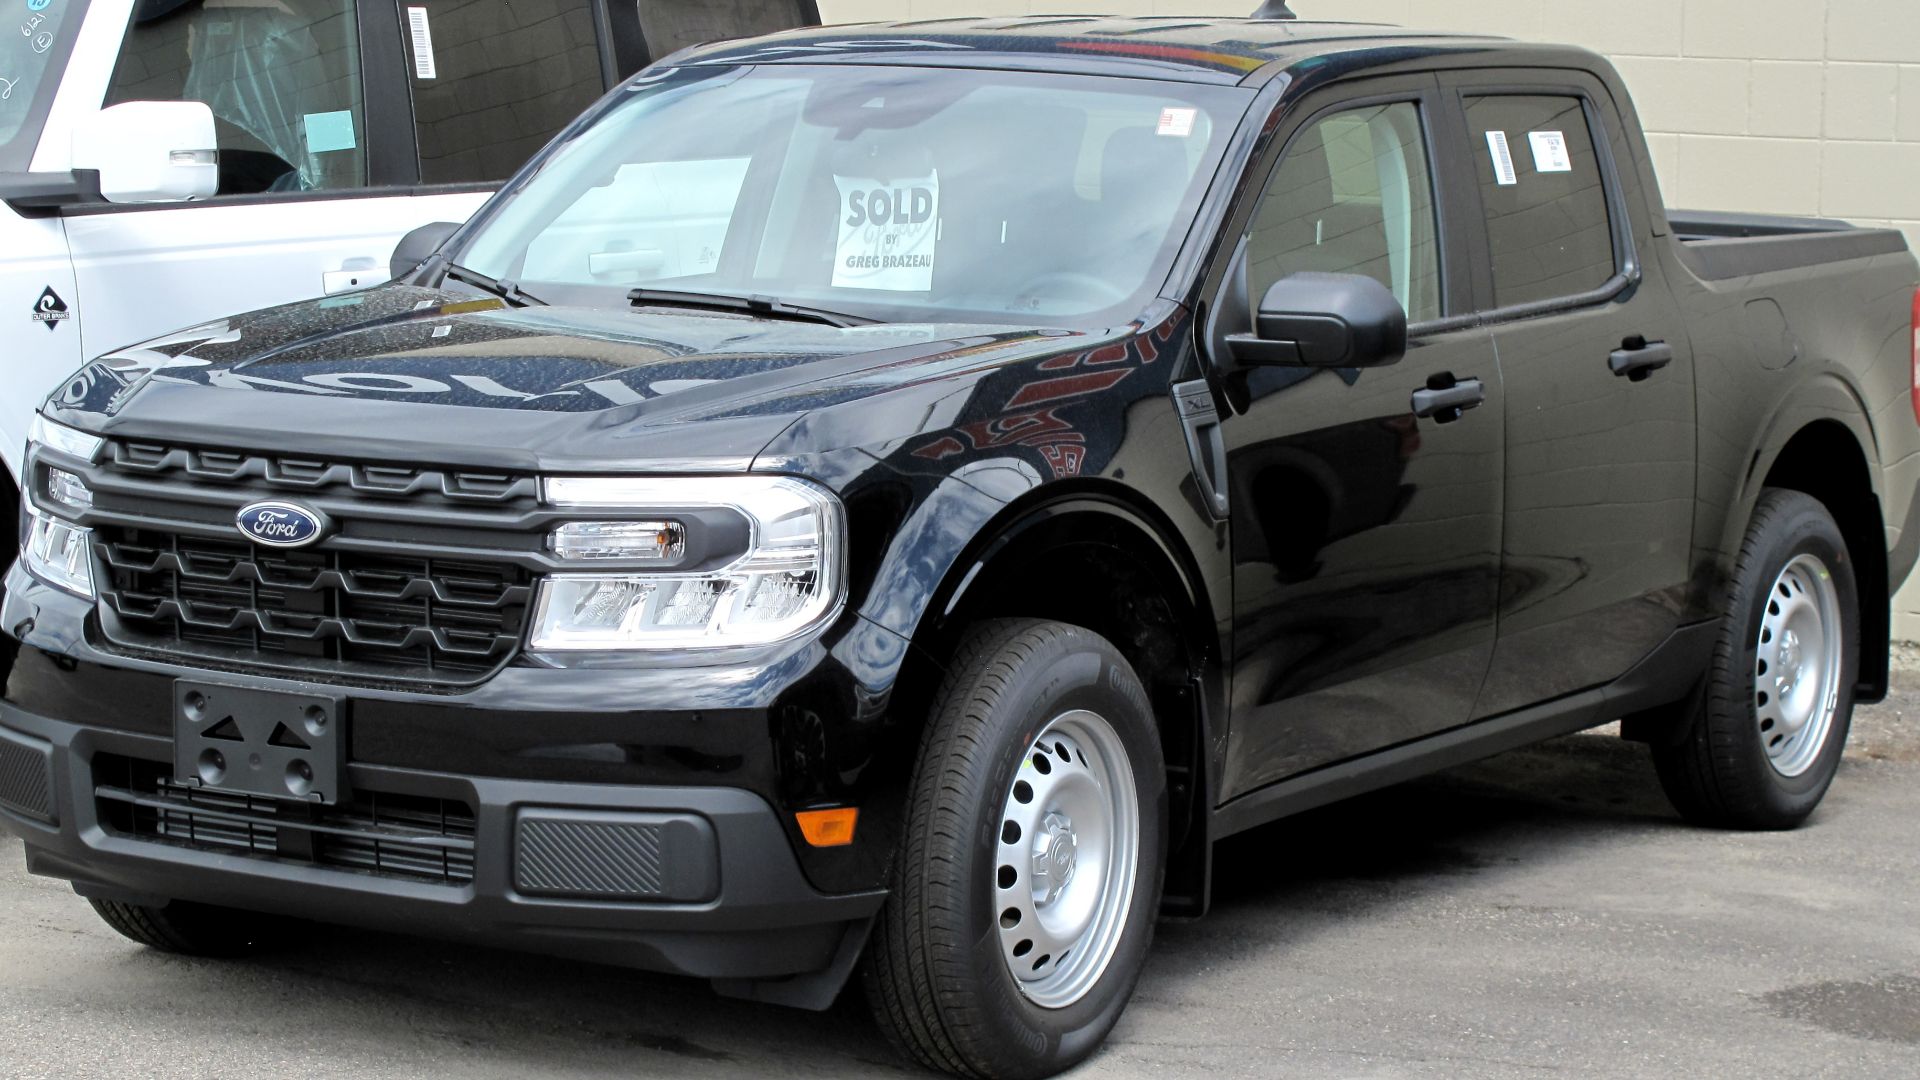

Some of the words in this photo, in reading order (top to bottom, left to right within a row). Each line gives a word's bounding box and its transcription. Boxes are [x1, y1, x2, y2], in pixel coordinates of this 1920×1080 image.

[846, 187, 933, 227] SOLD
[885, 234, 898, 244] BY
[845, 255, 880, 268] GREG
[882, 254, 931, 268] BRAZEAU
[1187, 398, 1211, 409] XL
[253, 510, 300, 537] Ford
